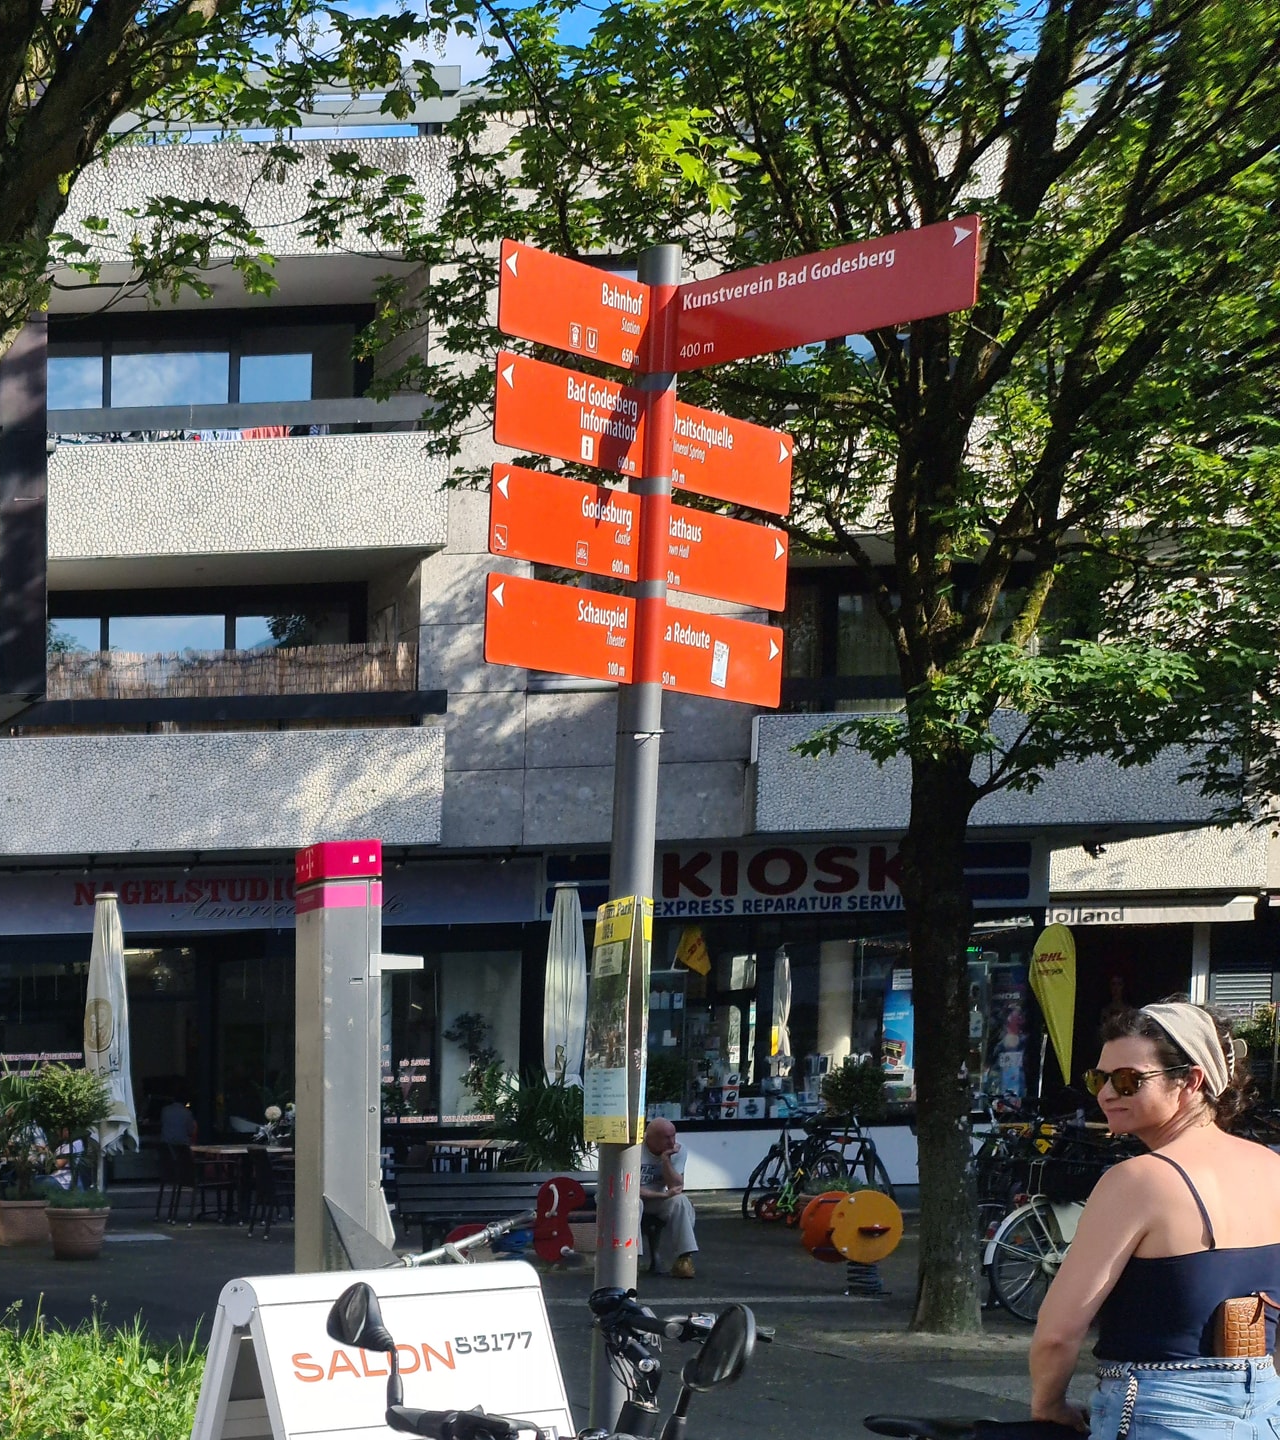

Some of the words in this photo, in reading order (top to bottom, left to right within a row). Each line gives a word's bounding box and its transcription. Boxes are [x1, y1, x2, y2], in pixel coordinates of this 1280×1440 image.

[683, 277, 773, 311] Kunstverein
[778, 266, 807, 288] Bad
[811, 249, 895, 281] Godesberg
[602, 282, 643, 315] Bahnhof
[621, 317, 641, 335] Station
[622, 348, 633, 363] 650
[633, 355, 640, 365] m
[680, 343, 701, 359] 400
[704, 341, 714, 354] m
[567, 376, 586, 403] Bad
[588, 383, 638, 422] Godesberg
[581, 406, 637, 443] Information
[689, 444, 705, 463] Spring
[617, 456, 628, 470] 600
[629, 461, 635, 472] m
[679, 473, 685, 484] m
[581, 495, 632, 531] Godesburg
[614, 529, 631, 546] Castle
[679, 544, 690, 559] Hall
[612, 559, 623, 574] 600
[624, 563, 630, 575] m
[674, 574, 680, 585] m
[577, 599, 628, 631] Schauspiel
[606, 631, 626, 648] Theater
[674, 622, 710, 649] Redoute
[607, 662, 618, 676] 100
[618, 665, 625, 677] m
[670, 675, 676, 686] m
[661, 847, 906, 899] KIOSK
[653, 899, 735, 917] EXPRESS
[743, 897, 842, 914] REPARATUR
[847, 895, 906, 911] SERVI
[1037, 951, 1066, 963] DHL
[291, 1340, 456, 1383] SALON
[454, 1331, 533, 1355] 53177
